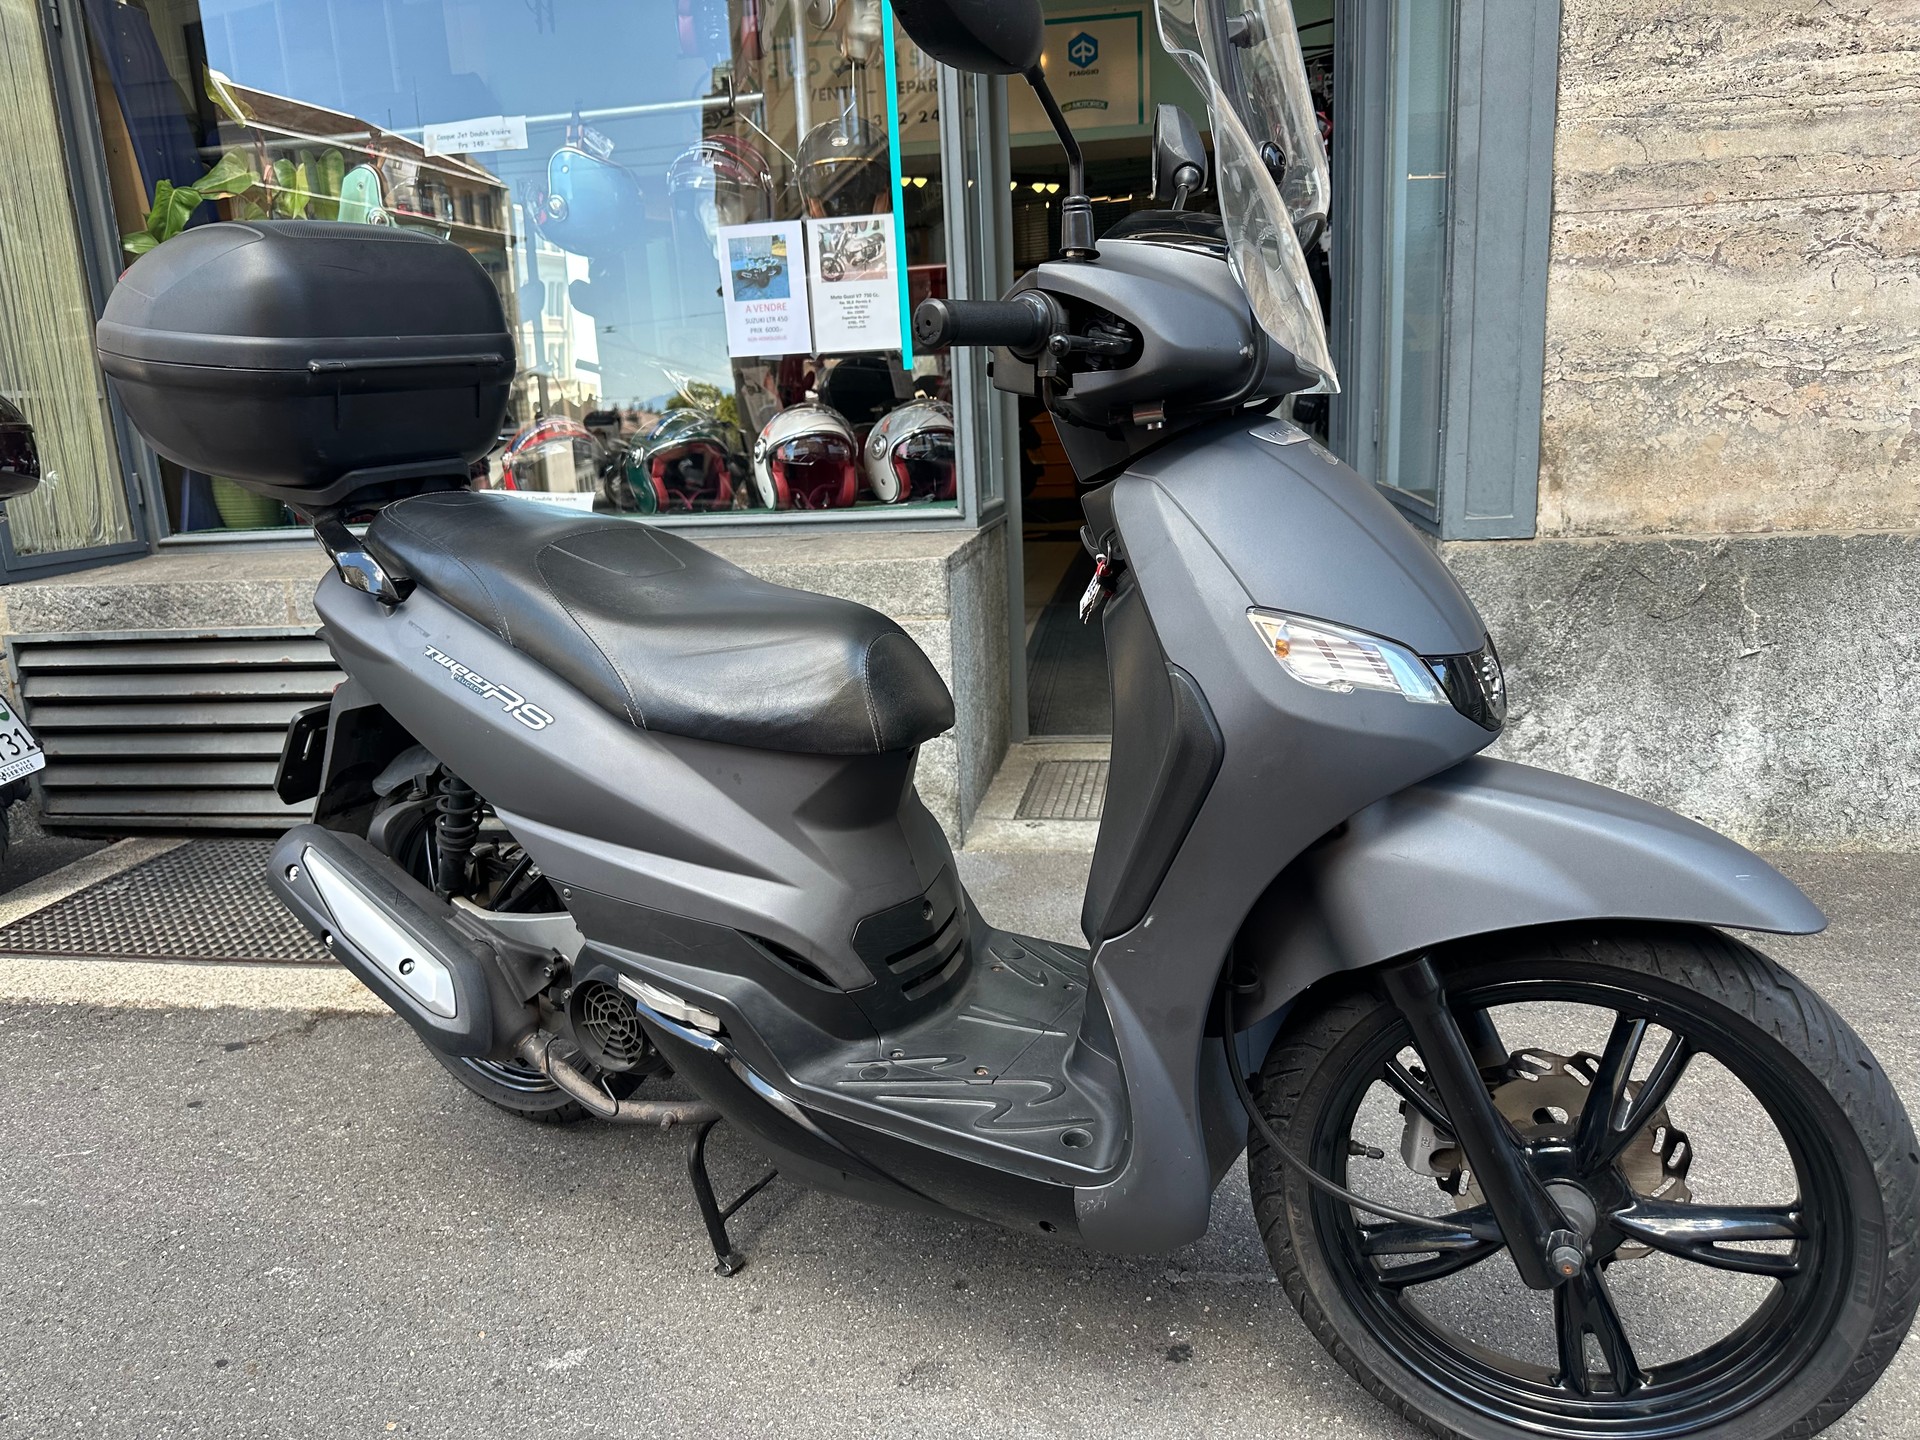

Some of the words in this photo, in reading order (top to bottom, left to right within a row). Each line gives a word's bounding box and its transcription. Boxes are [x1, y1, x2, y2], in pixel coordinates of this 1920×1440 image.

[1069, 69, 1099, 77] PIAGGIO
[470, 130, 489, 138] Double
[753, 302, 787, 313] VENDRE
[745, 317, 765, 325] SUZUKI
[452, 673, 484, 696] PEUGEOT
[482, 683, 556, 731] RS
[0, 728, 35, 760] 31
[6, 762, 35, 779] SERVICE
